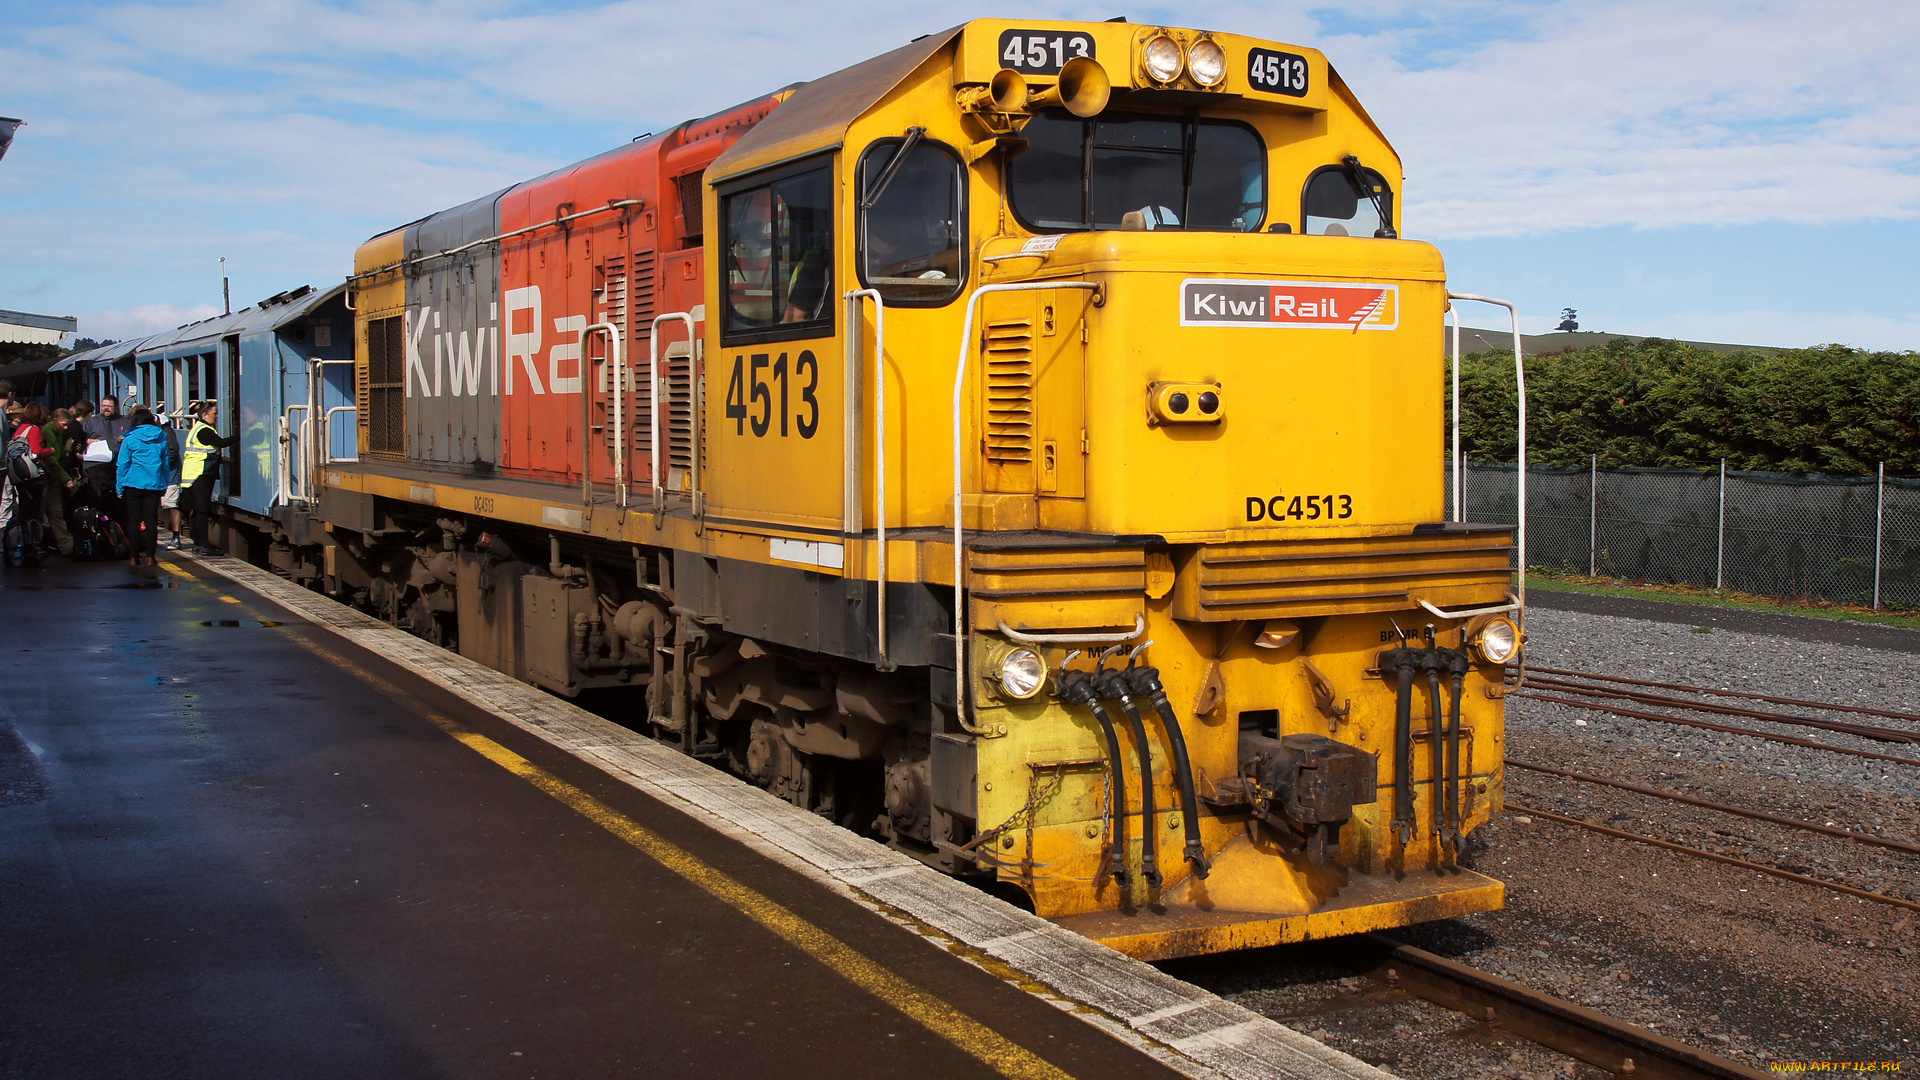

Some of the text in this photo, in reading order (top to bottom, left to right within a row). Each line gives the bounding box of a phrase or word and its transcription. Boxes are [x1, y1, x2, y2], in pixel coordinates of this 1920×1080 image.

[1003, 36, 1089, 68] 4513
[1251, 54, 1306, 90] 4513
[725, 349, 819, 439] 4513
[474, 495, 494, 513] DC4513
[1246, 494, 1353, 522] DC4513
[1380, 631, 1395, 641] BP
